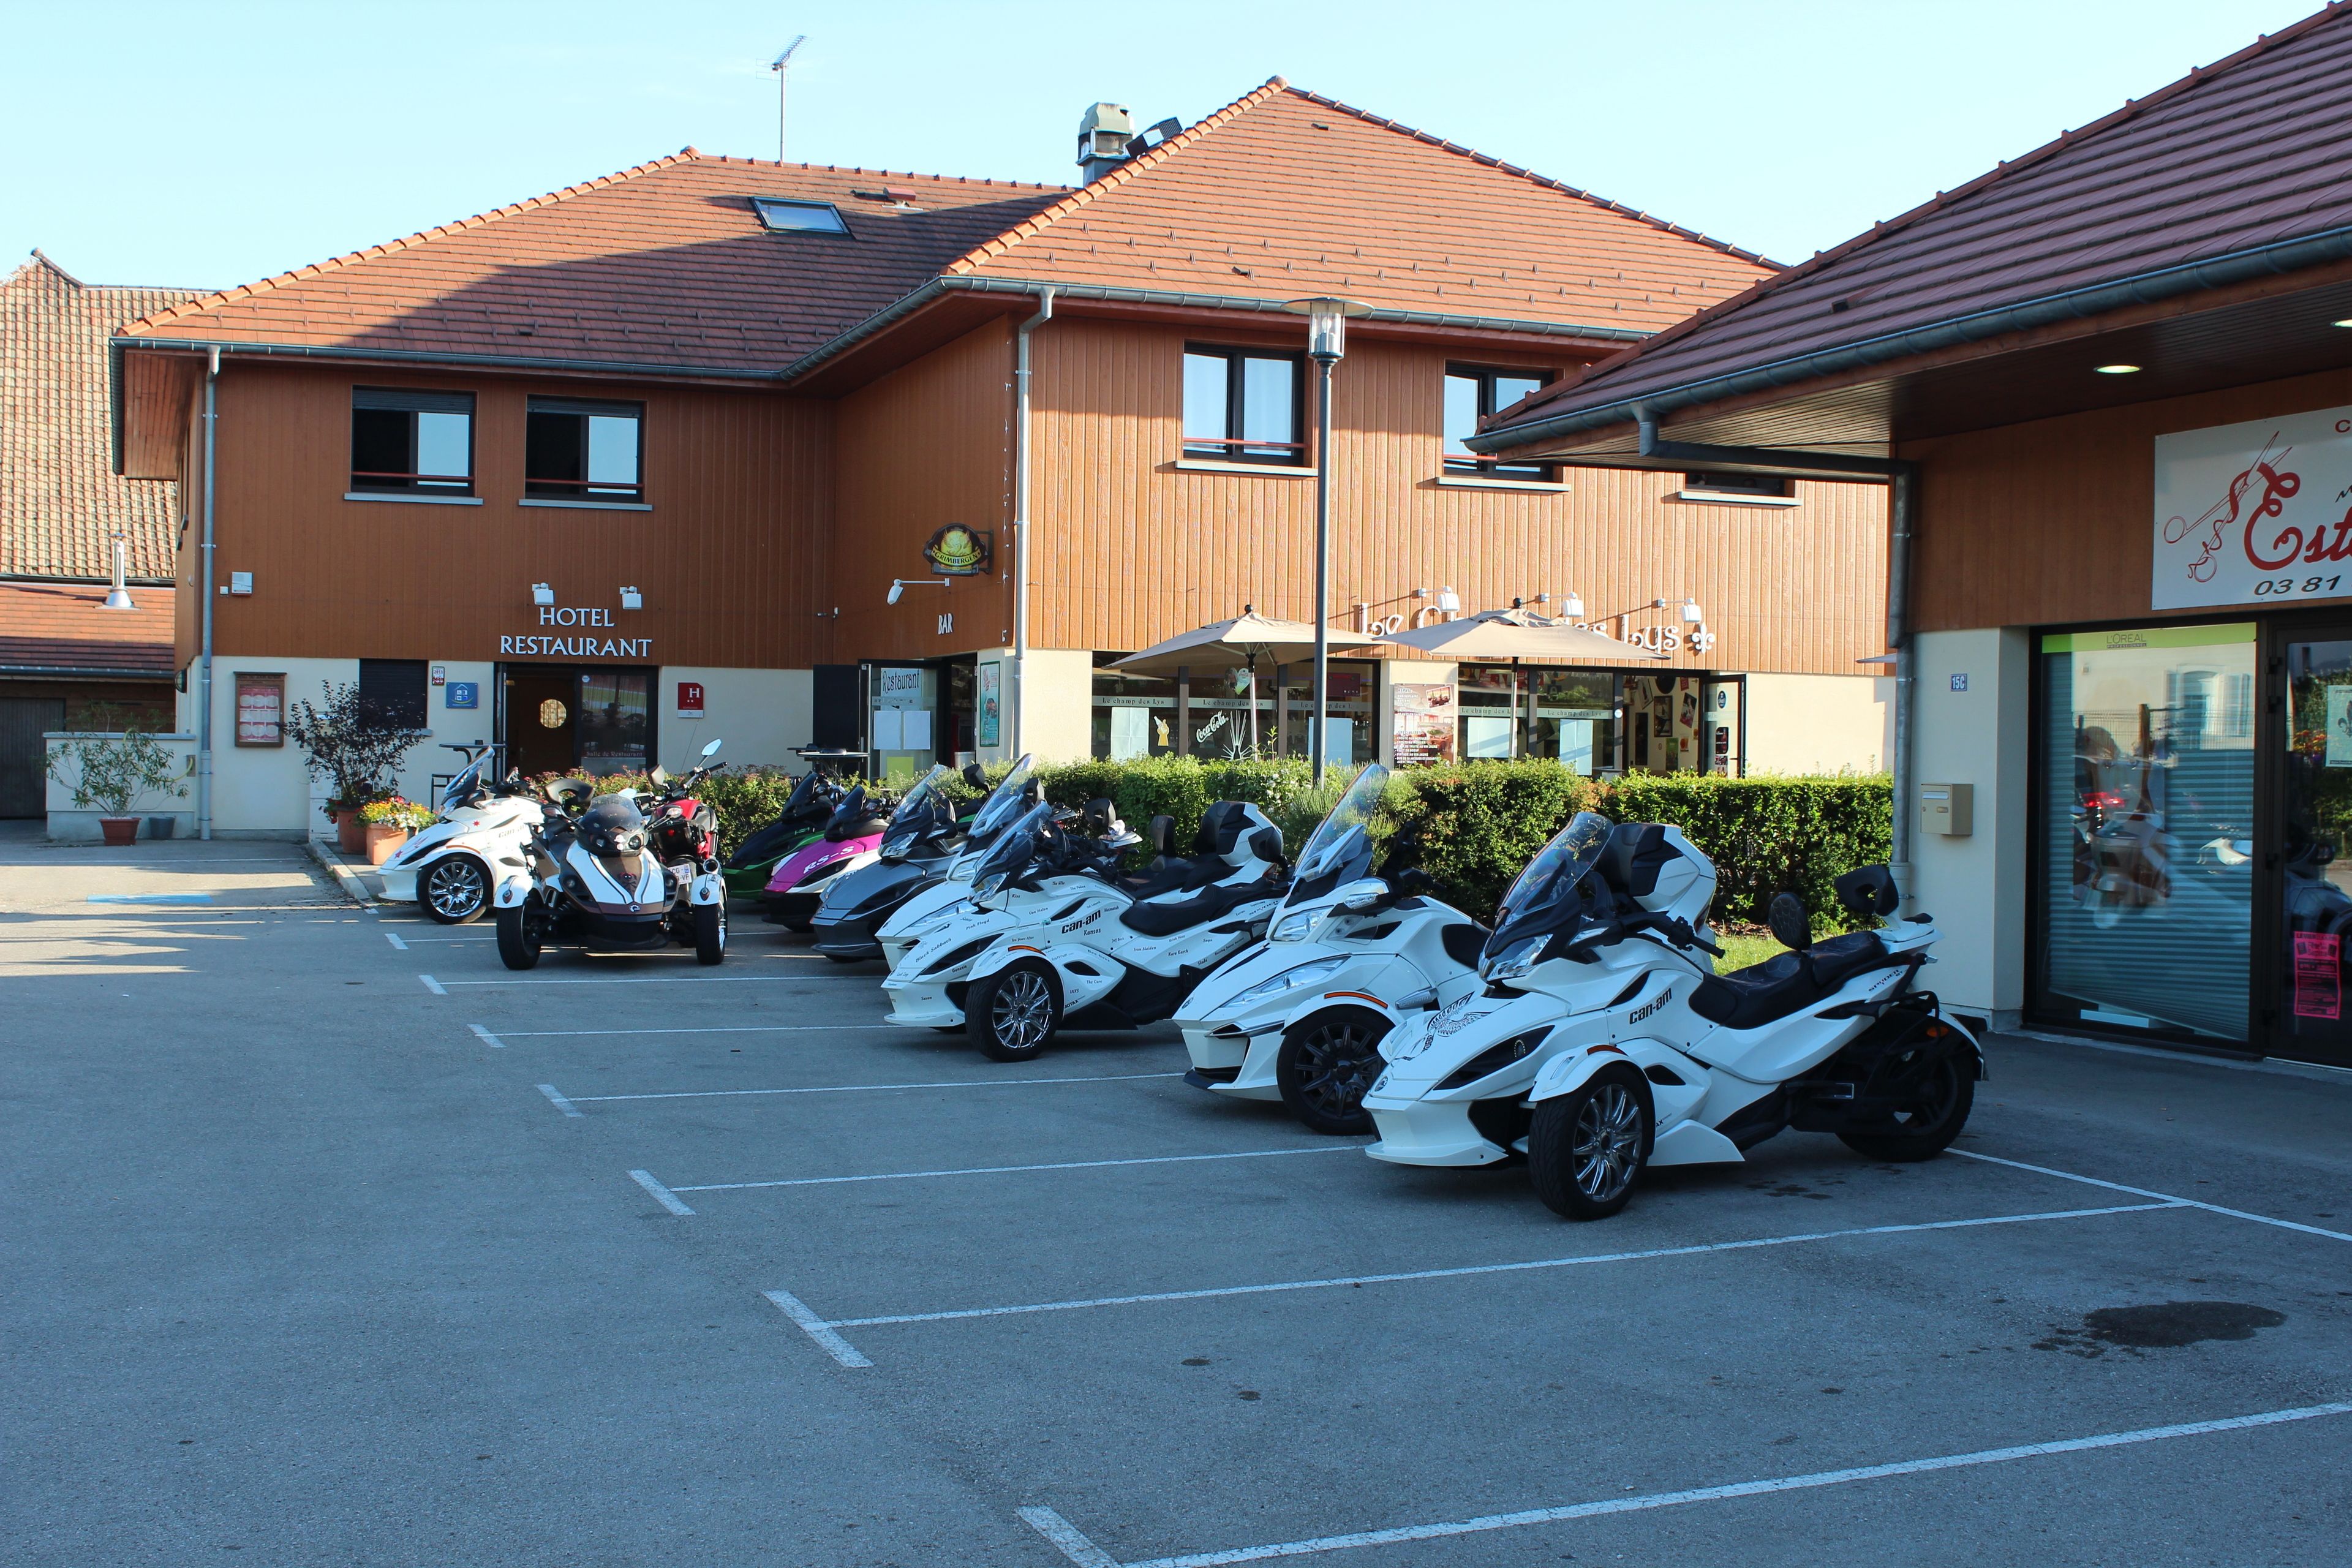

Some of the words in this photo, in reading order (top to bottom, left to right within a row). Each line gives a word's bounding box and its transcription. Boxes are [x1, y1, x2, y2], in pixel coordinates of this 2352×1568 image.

[935, 552, 978, 564] GRIMBERGEN
[2254, 579, 2293, 595] 03
[2301, 575, 2341, 592] 81
[539, 607, 615, 627] HOTEL
[938, 612, 952, 635] BAR
[1361, 603, 1404, 638] Le
[1621, 614, 1681, 654] Lys
[500, 635, 652, 657] RESTAURANT
[883, 669, 919, 693] Restaurant
[1952, 676, 1965, 689] 15C
[689, 688, 699, 698] H
[1196, 710, 1226, 742] Coca-Cola
[1061, 910, 1101, 934] can-am
[916, 951, 930, 963] Black
[931, 938, 952, 952] Sabbath
[952, 965, 967, 973] Genesis
[1629, 987, 1672, 1025] can-am
